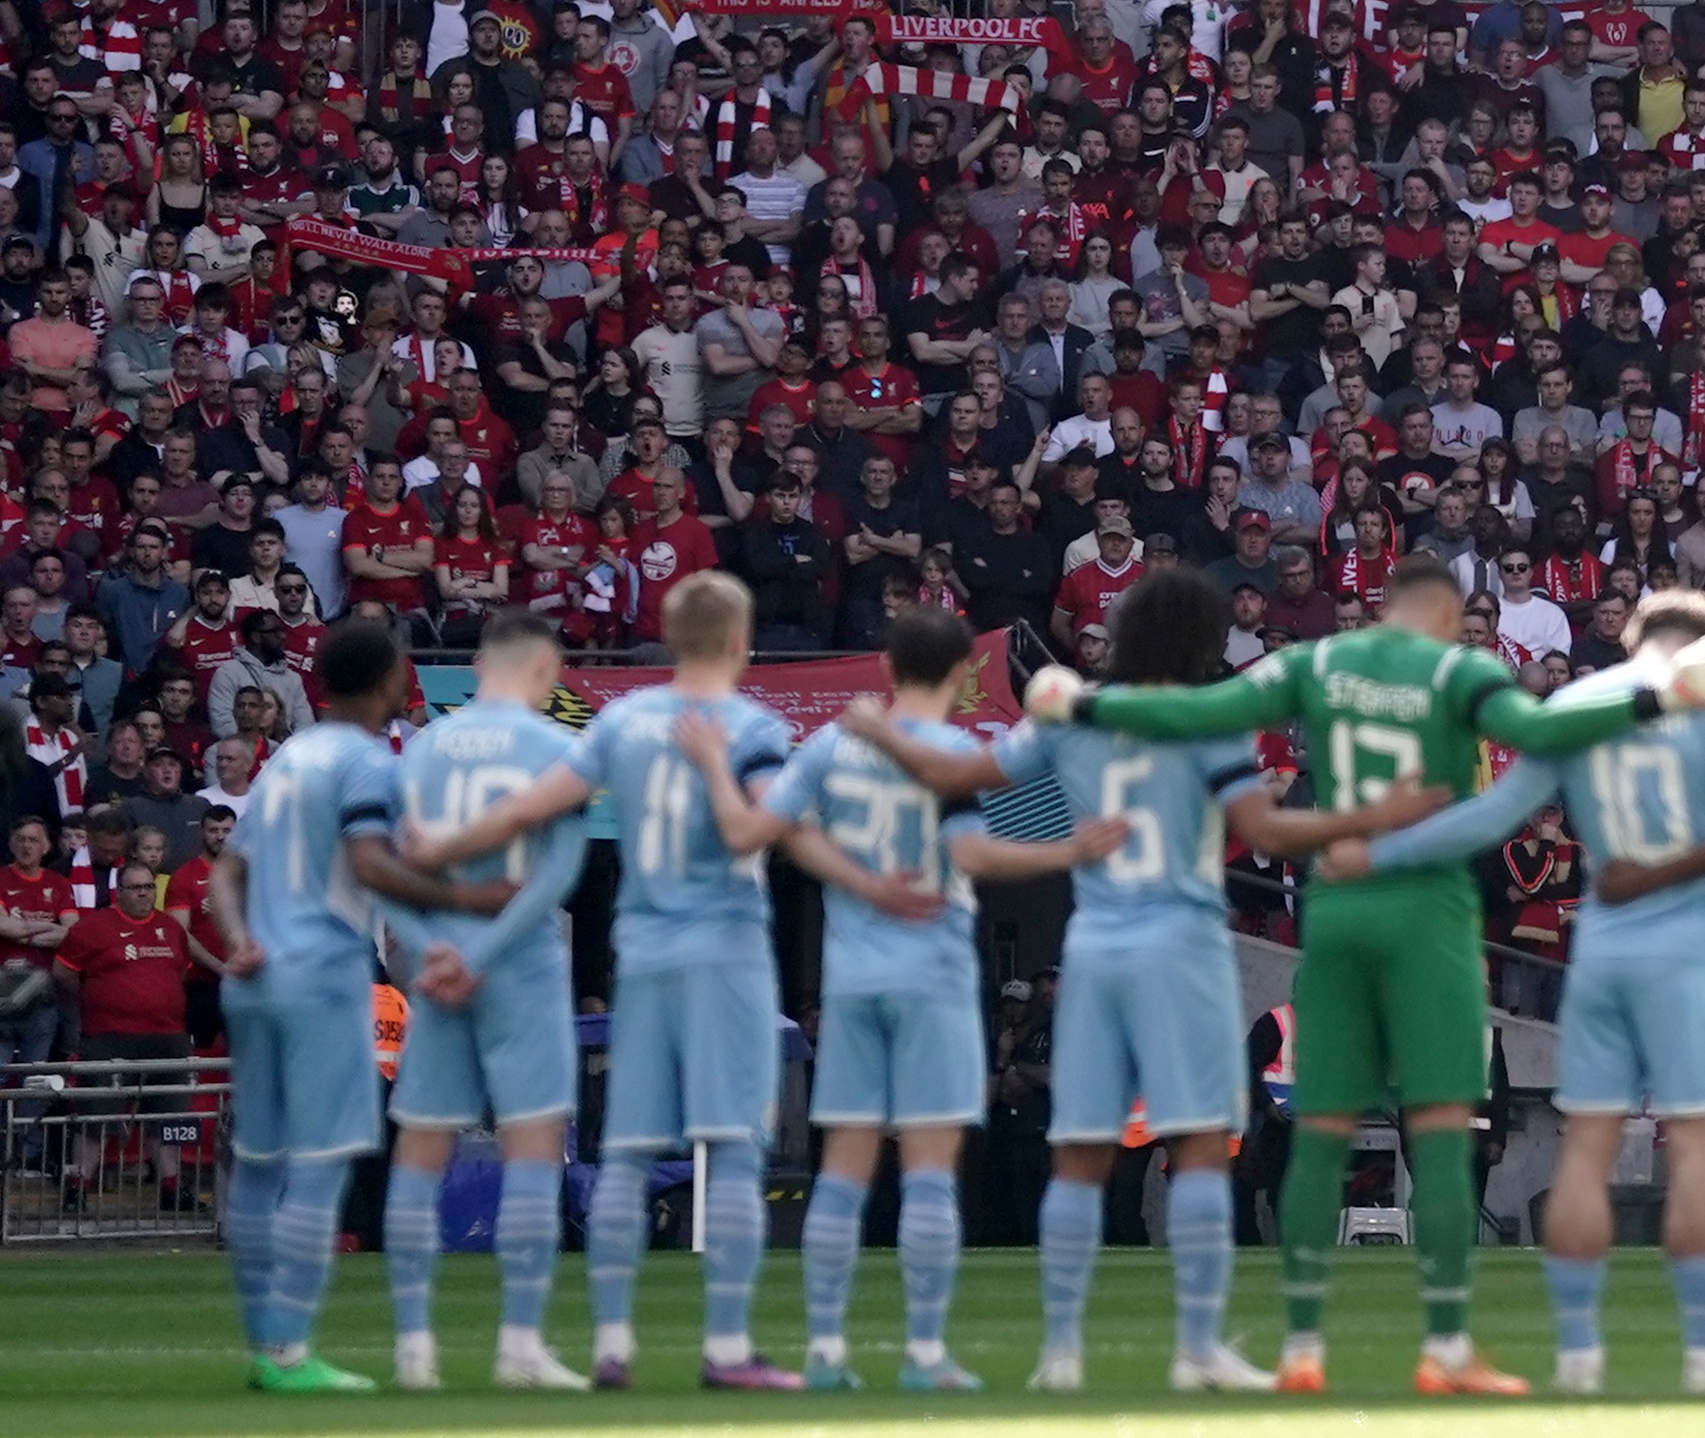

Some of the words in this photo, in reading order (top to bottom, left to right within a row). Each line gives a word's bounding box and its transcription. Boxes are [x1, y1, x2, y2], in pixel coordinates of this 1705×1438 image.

[891, 18, 1013, 40] LIVERPOOL
[1017, 18, 1046, 39] FC
[322, 223, 357, 244] NEVER
[360, 233, 398, 252] WALK
[399, 241, 433, 260] ALONE
[1590, 739, 1694, 866] 10
[163, 1126, 198, 1142] B128
